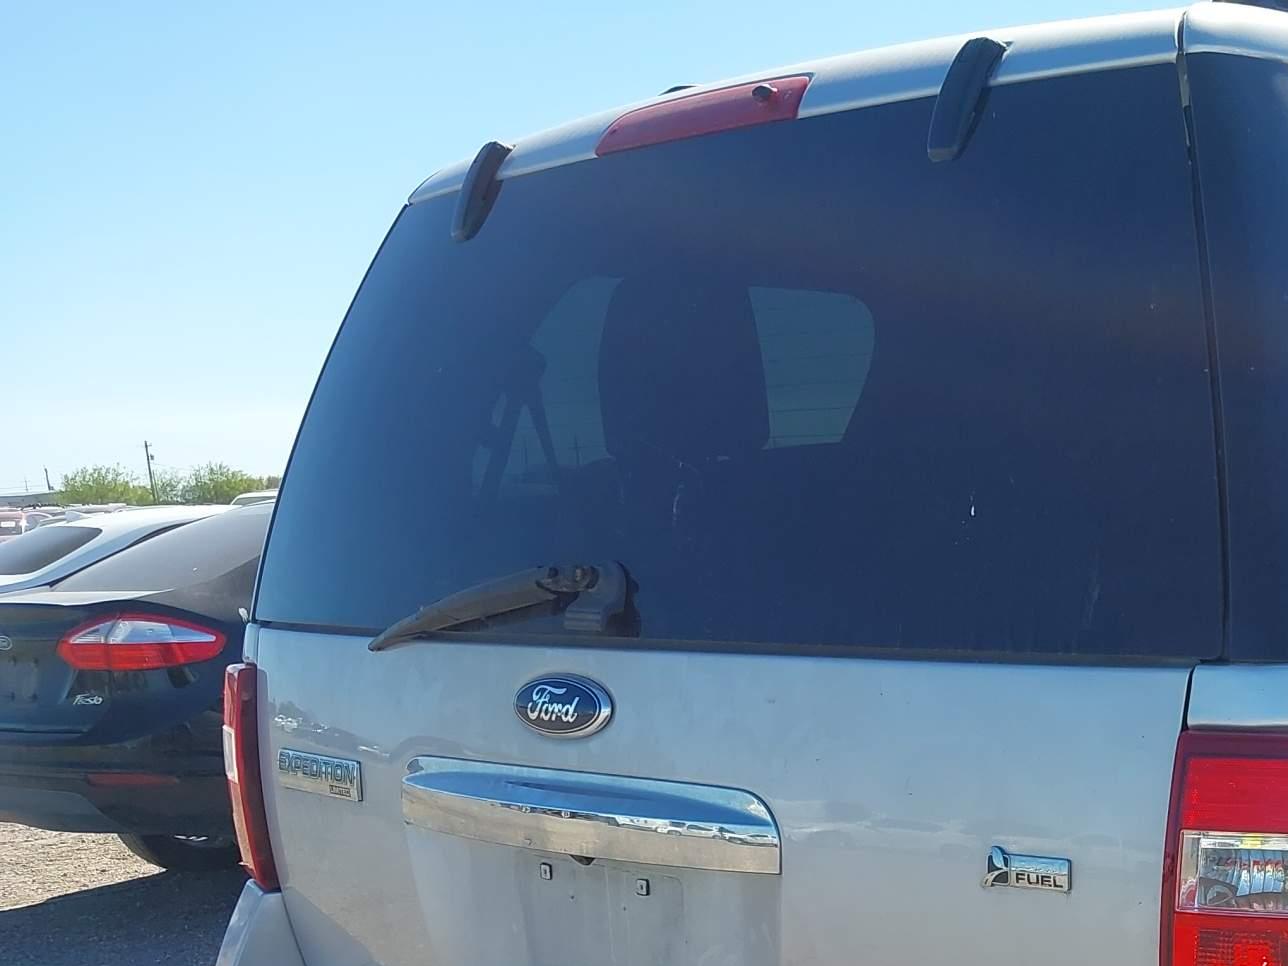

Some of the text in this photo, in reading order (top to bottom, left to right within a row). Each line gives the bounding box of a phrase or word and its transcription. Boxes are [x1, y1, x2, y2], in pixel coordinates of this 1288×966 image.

[527, 685, 580, 722] Ford
[278, 751, 356, 787] EXPEDITION
[1015, 872, 1064, 889] FUEL
